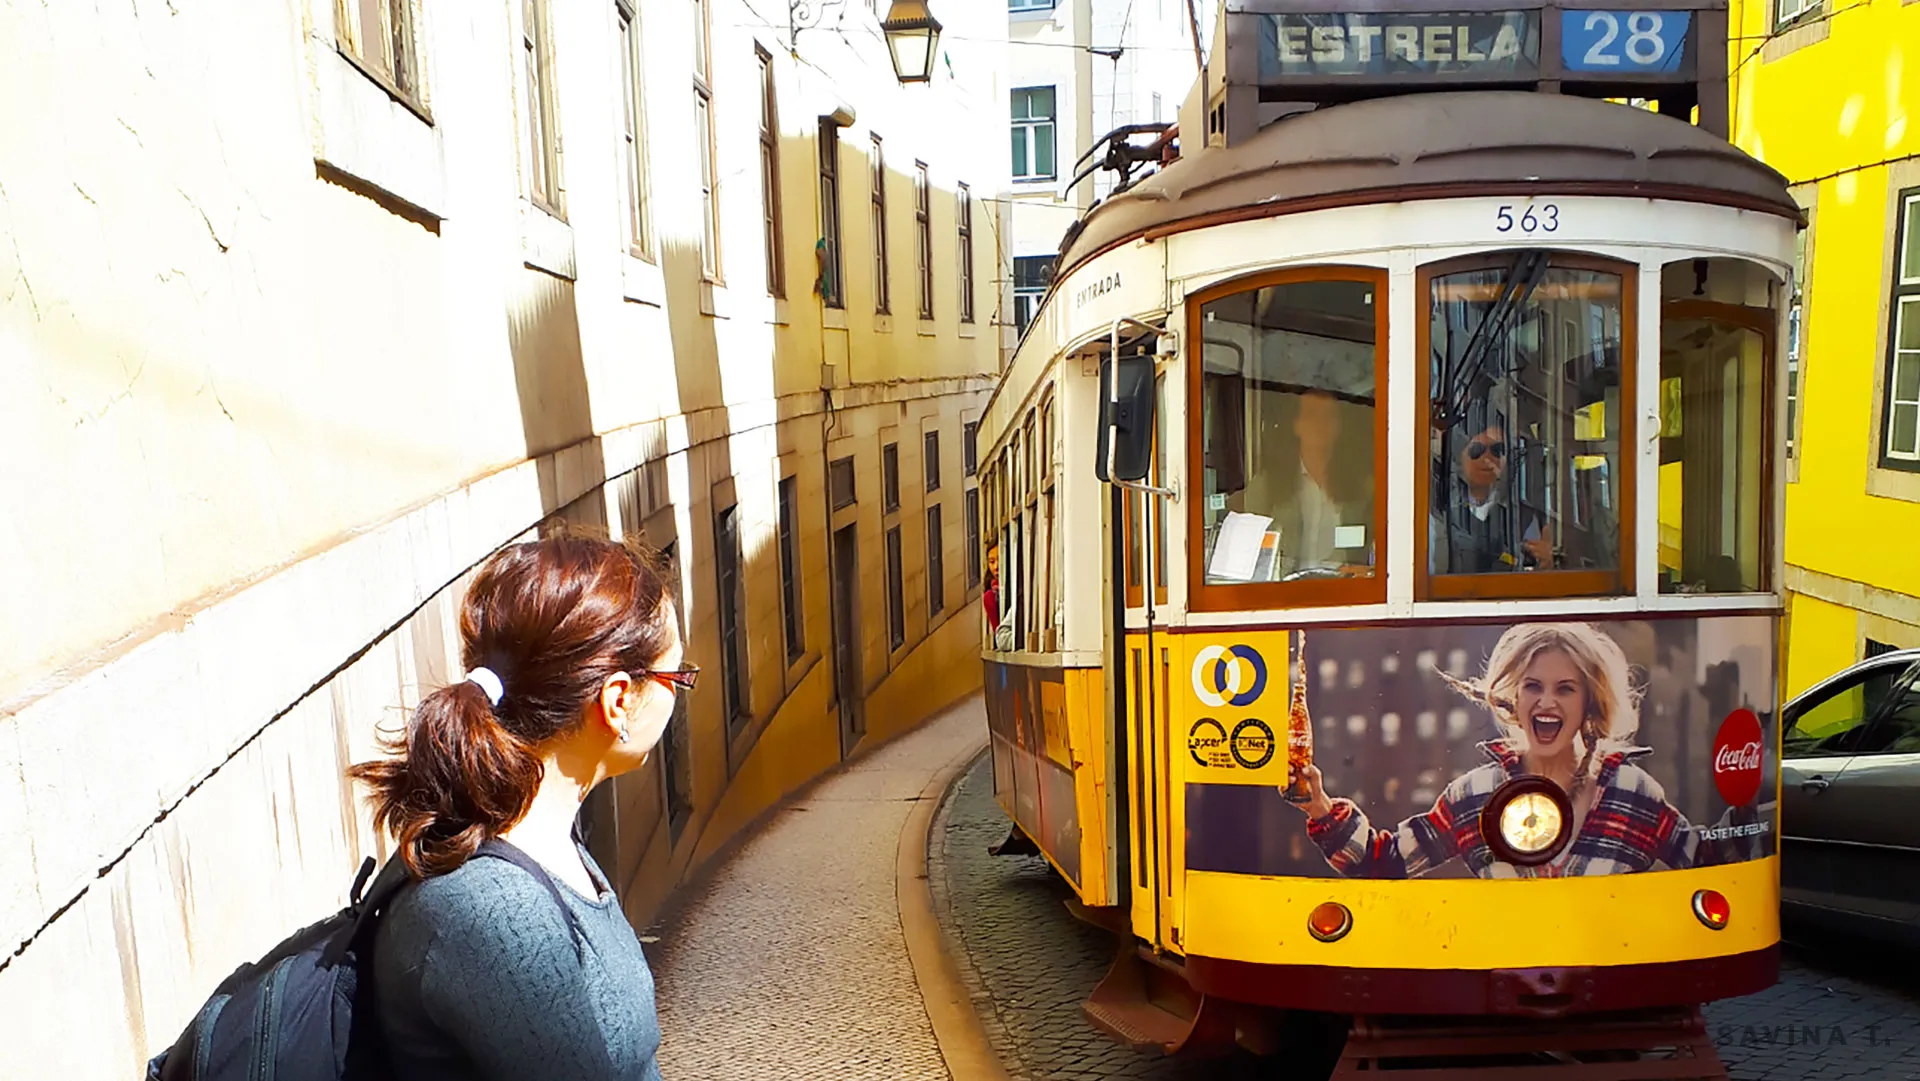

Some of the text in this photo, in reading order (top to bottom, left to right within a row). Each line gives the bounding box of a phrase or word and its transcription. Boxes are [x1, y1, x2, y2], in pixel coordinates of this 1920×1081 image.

[1277, 25, 1520, 63] ESTRELA
[1583, 10, 1665, 66] 28
[1496, 204, 1560, 233] 563
[1076, 271, 1122, 309] ENTRADA
[1700, 821, 1769, 841] TASTE THE FEELING
